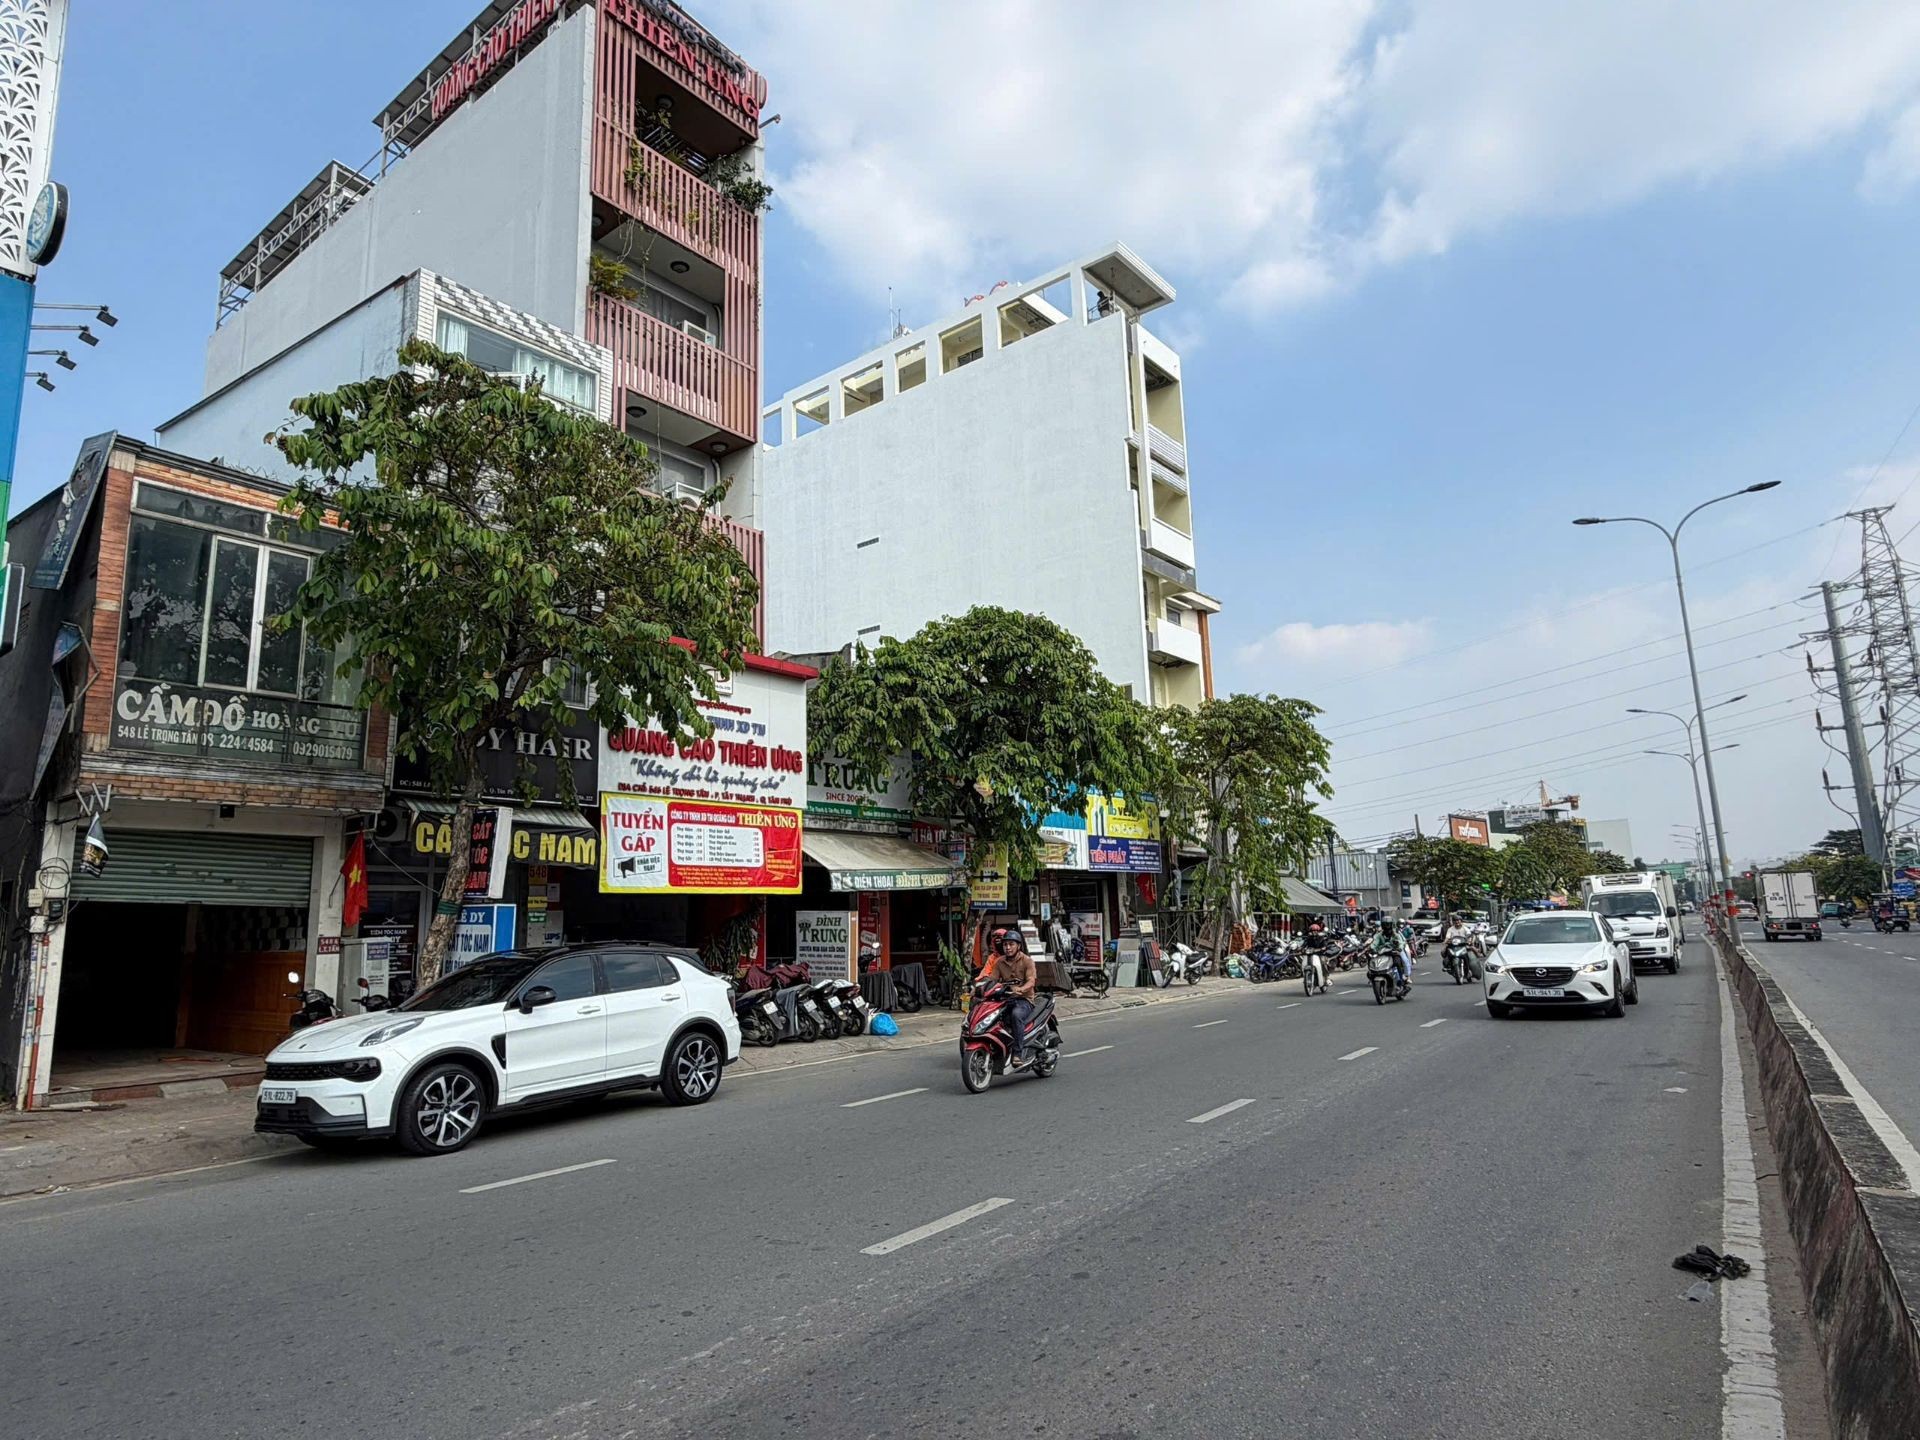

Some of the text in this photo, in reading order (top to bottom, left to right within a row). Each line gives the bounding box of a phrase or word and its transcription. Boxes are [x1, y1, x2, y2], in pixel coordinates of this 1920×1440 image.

[117, 724, 136, 739] 548
[137, 724, 149, 740] LÊ
[151, 728, 180, 745] TRỌNG
[825, 792, 845, 802] SINCE
[610, 807, 664, 831] TUYỂN
[736, 811, 772, 827] THIÊN
[774, 813, 797, 829] ỨNG
[539, 832, 597, 866] NAM
[621, 831, 656, 853] GẤP
[469, 911, 486, 923] DY
[815, 914, 842, 927] ĐÌNH
[461, 929, 473, 953] TÓC
[474, 933, 489, 953] NAM
[799, 927, 848, 943] TRUNG
